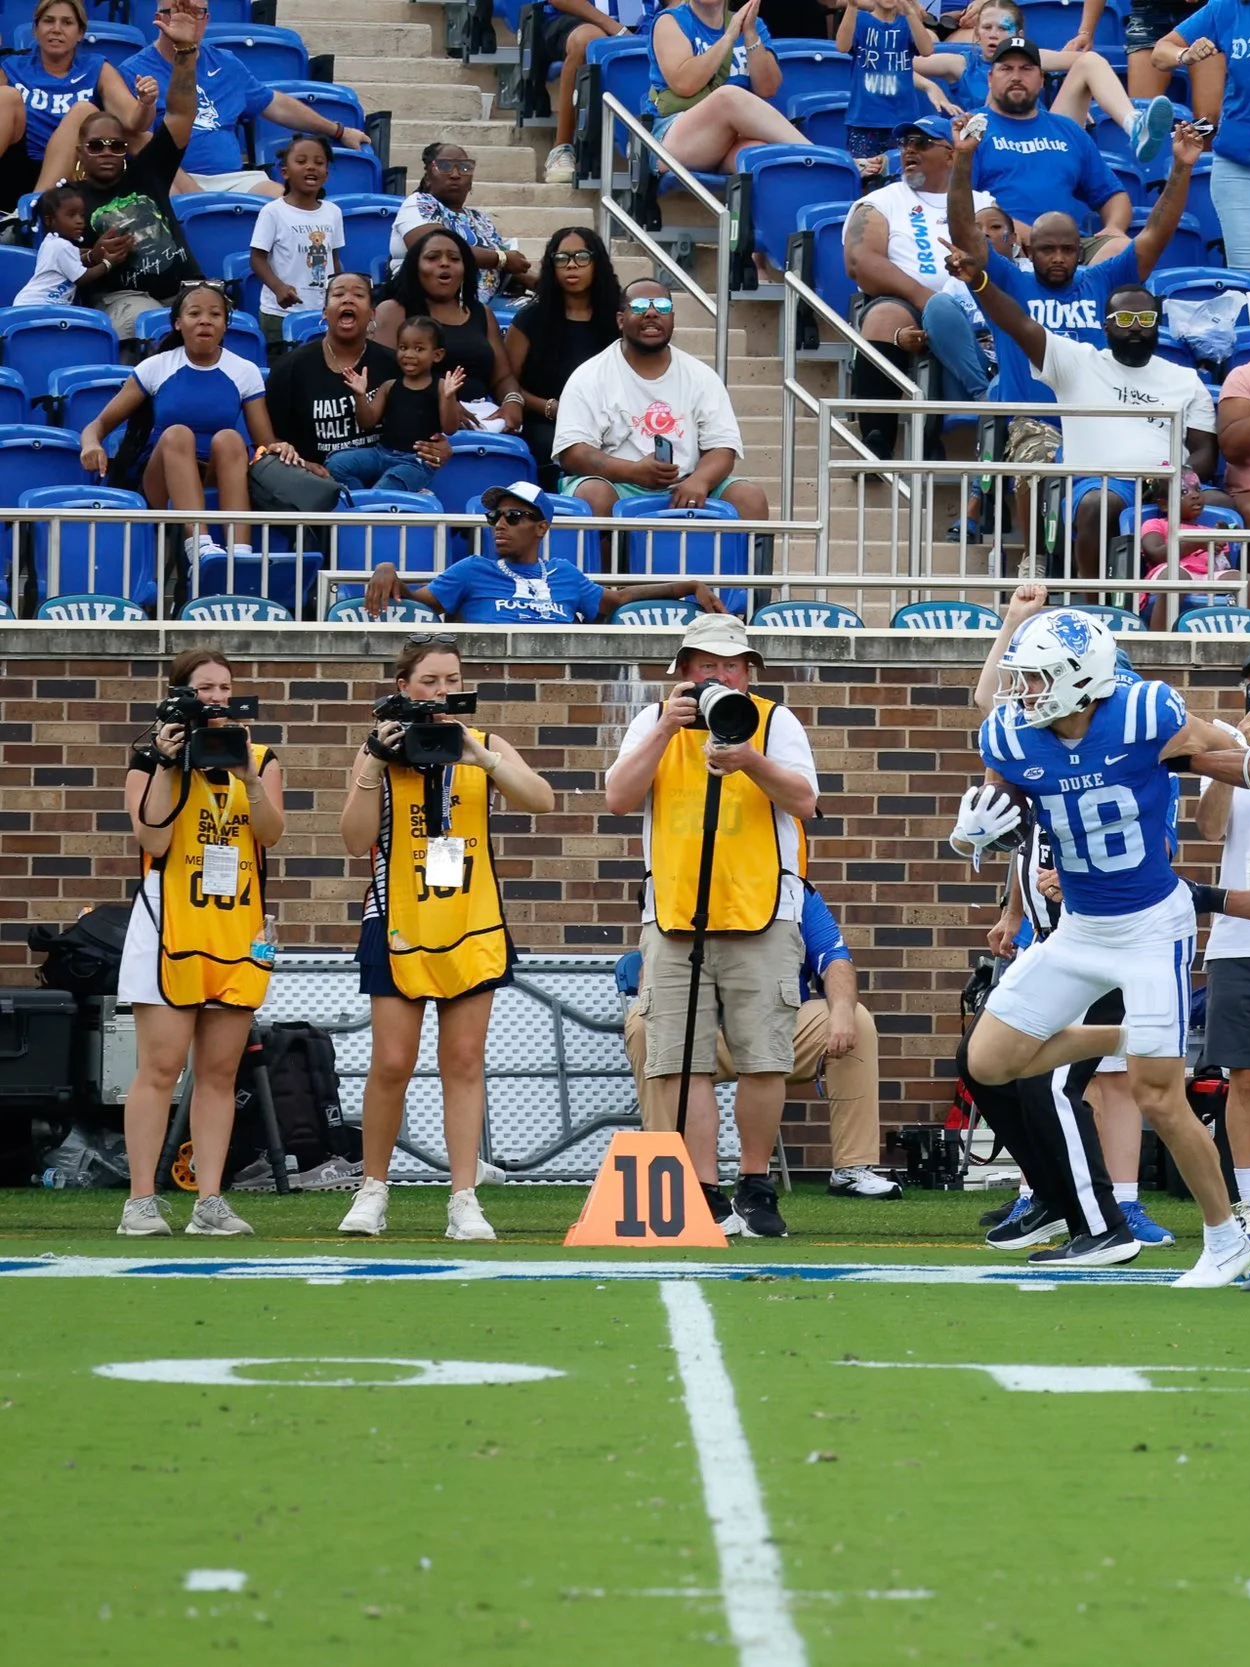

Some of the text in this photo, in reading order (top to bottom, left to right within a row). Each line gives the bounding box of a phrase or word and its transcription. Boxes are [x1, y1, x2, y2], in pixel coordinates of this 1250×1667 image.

[866, 27, 901, 48] IN IT
[1011, 37, 1025, 47] D
[887, 49, 911, 71] THE
[864, 73, 897, 96] WIN
[909, 212, 937, 275] BROWN
[1027, 299, 1102, 330] DUKE
[313, 396, 348, 419] HALF
[315, 418, 351, 440] HALF
[618, 607, 705, 625] DUK
[1069, 754, 1080, 765] D
[1059, 772, 1105, 793] DUKE
[1040, 784, 1146, 873] 18
[1040, 844, 1051, 864] F
[614, 1155, 686, 1238] 10
